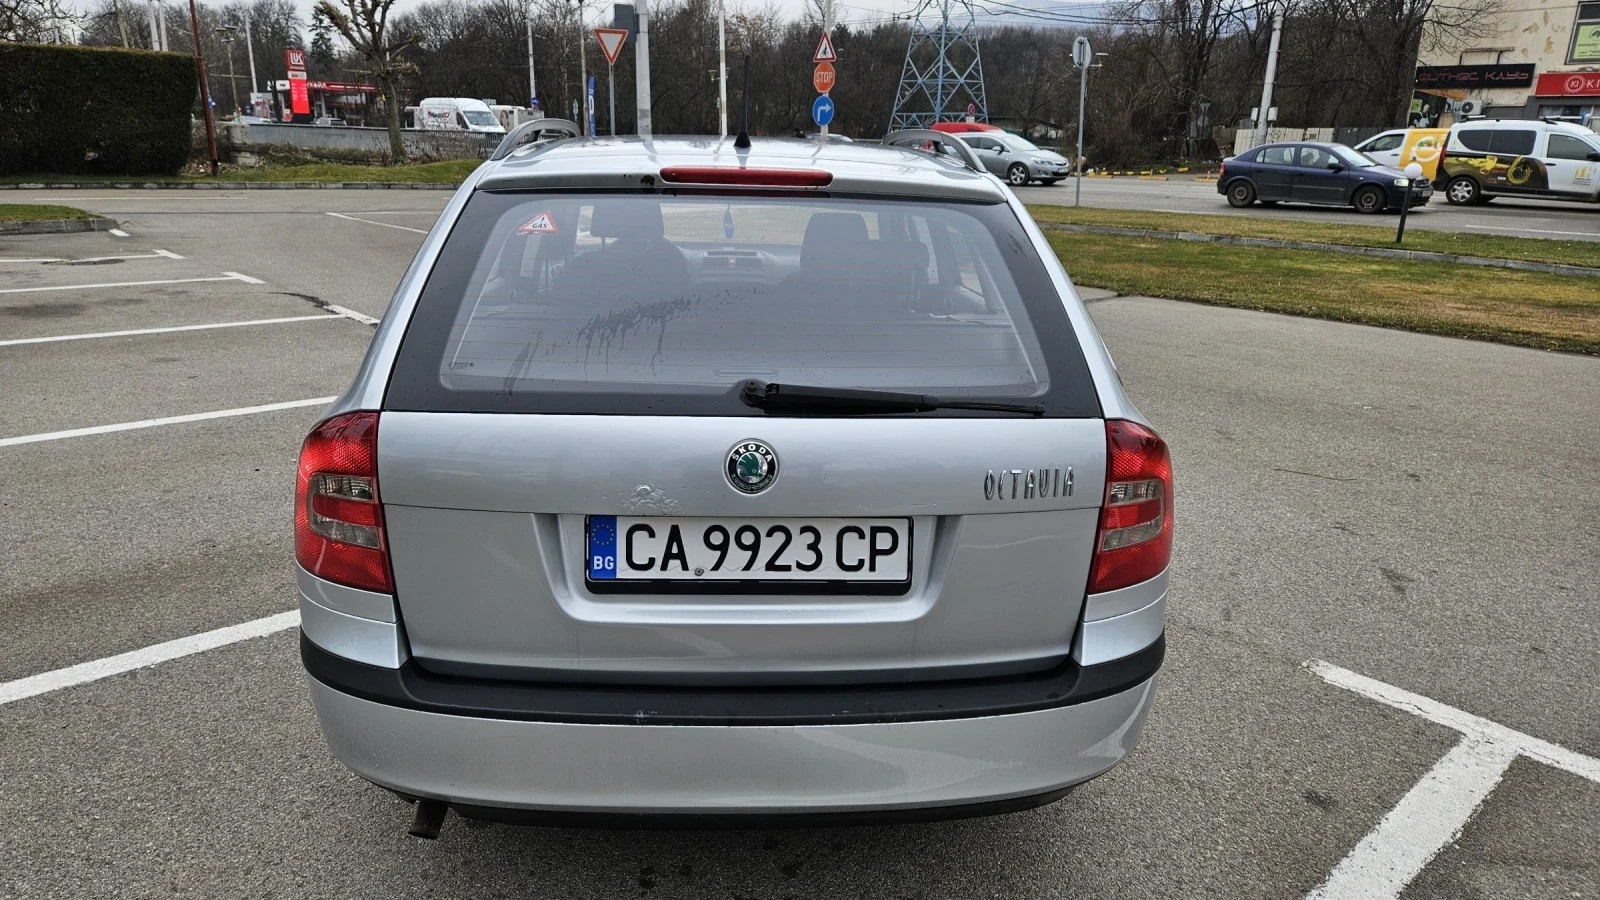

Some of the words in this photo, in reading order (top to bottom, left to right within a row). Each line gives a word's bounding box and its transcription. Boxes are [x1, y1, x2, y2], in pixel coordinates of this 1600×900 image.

[816, 71, 833, 83] STOP
[983, 466, 1075, 500] OCTAVIA
[625, 523, 690, 572] CA
[703, 524, 823, 572] 9923
[835, 525, 899, 572] CP
[593, 555, 614, 570] BG
